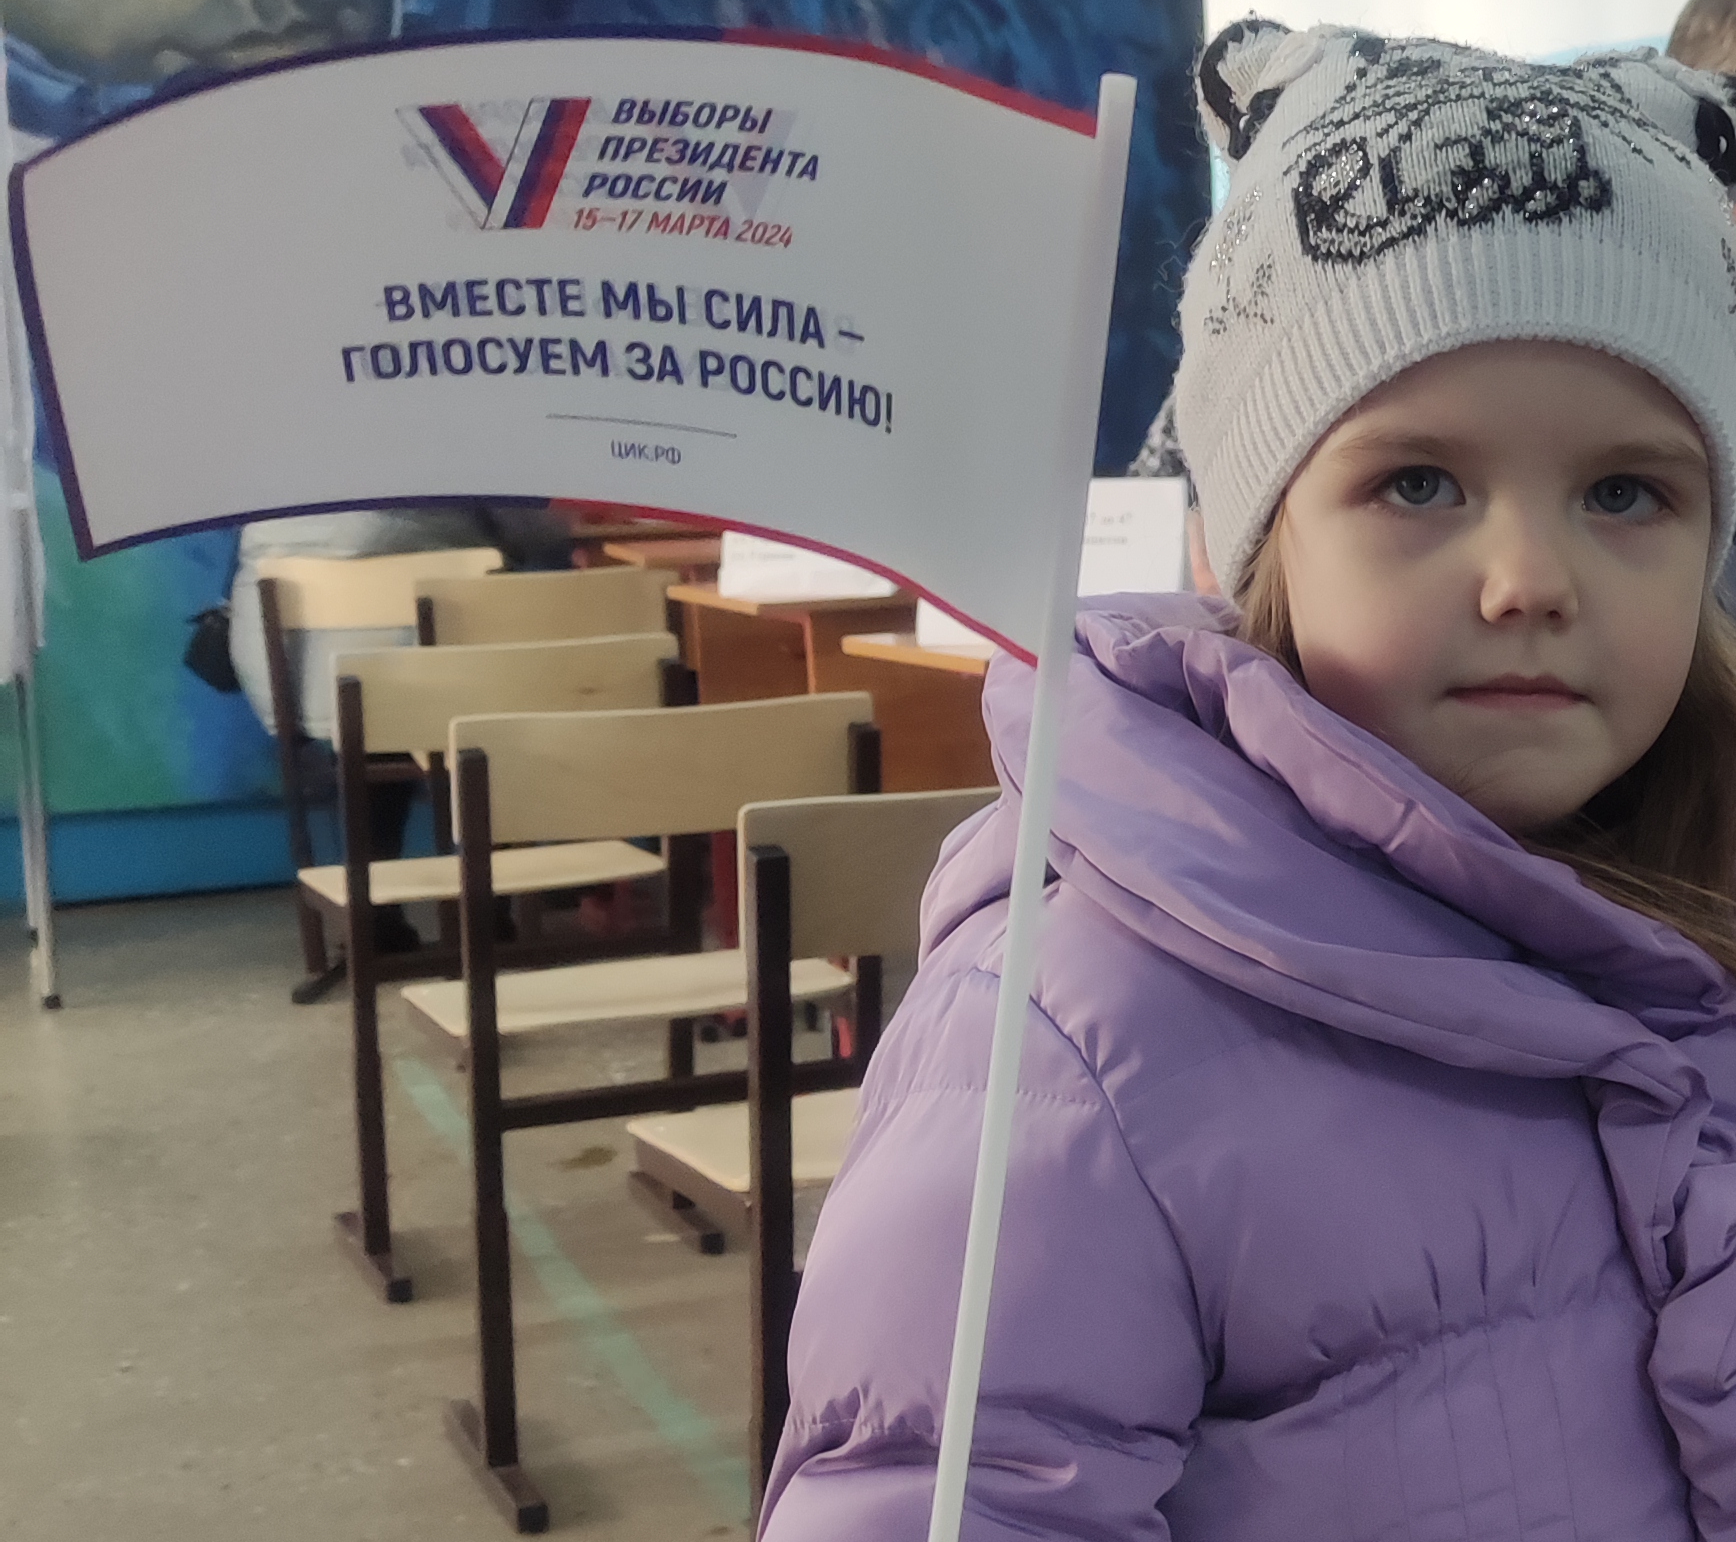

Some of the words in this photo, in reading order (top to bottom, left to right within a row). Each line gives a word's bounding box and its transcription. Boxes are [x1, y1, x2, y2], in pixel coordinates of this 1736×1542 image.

[611, 98, 773, 135] ВЫБОРЫ
[598, 135, 821, 181] ПРЕЗИДЕНТА
[582, 172, 730, 206] РОССИИ
[646, 211, 731, 239] МАРТА
[735, 221, 794, 248] 2024
[383, 278, 586, 323] ВМЕСТЕ
[601, 279, 686, 326] МЫ
[705, 288, 825, 349] СИЛА
[340, 337, 610, 383] ГОЛОСУЕМ
[624, 341, 684, 386] ЗА
[698, 349, 894, 434] РОССИЮ!
[609, 439, 683, 465] ЦИК.РФ
